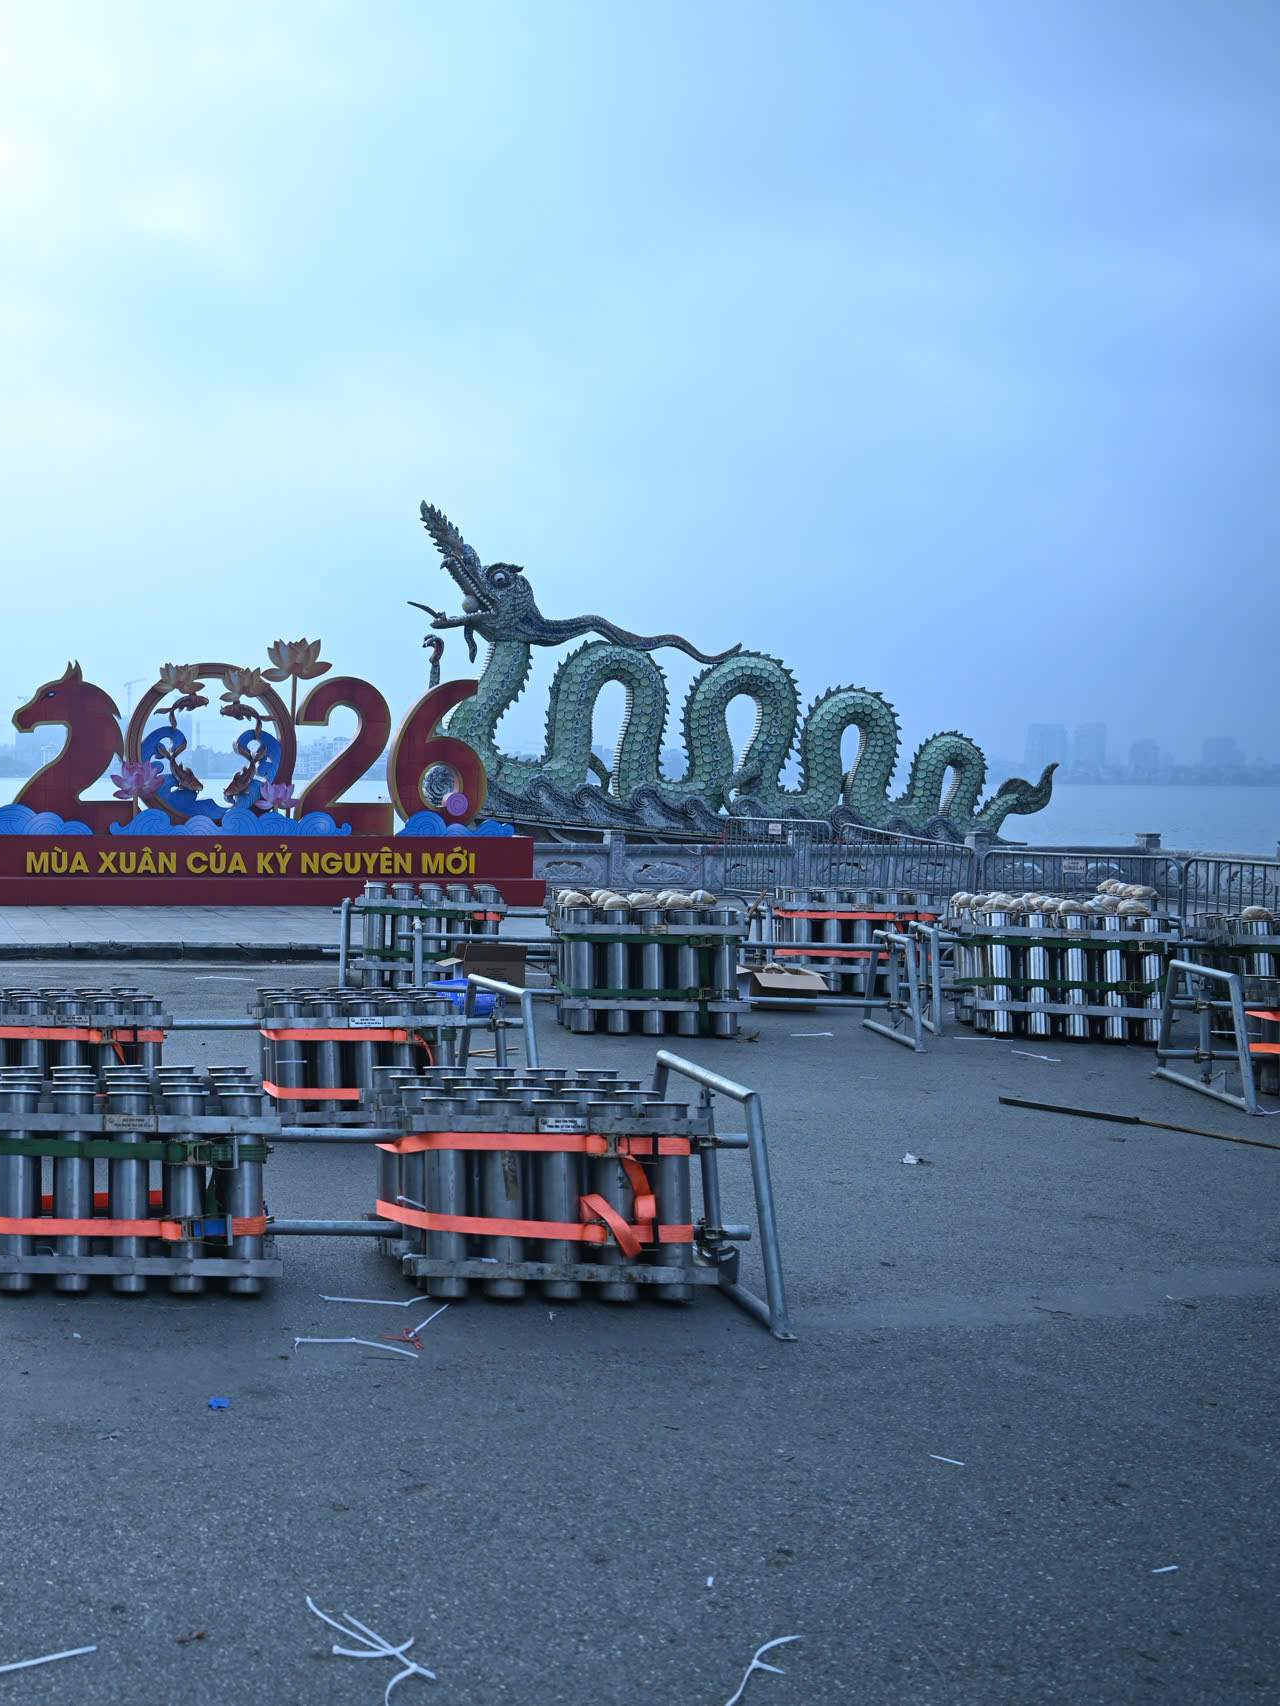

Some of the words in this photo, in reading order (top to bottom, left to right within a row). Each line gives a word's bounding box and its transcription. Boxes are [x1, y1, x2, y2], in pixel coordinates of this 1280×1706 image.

[26, 845, 89, 873] MÙA
[97, 846, 177, 874] XUÂN
[186, 843, 248, 874] CỦA
[256, 843, 293, 874] KỶ
[300, 845, 413, 875] NGUYÊN
[421, 845, 476, 875] MỚI
